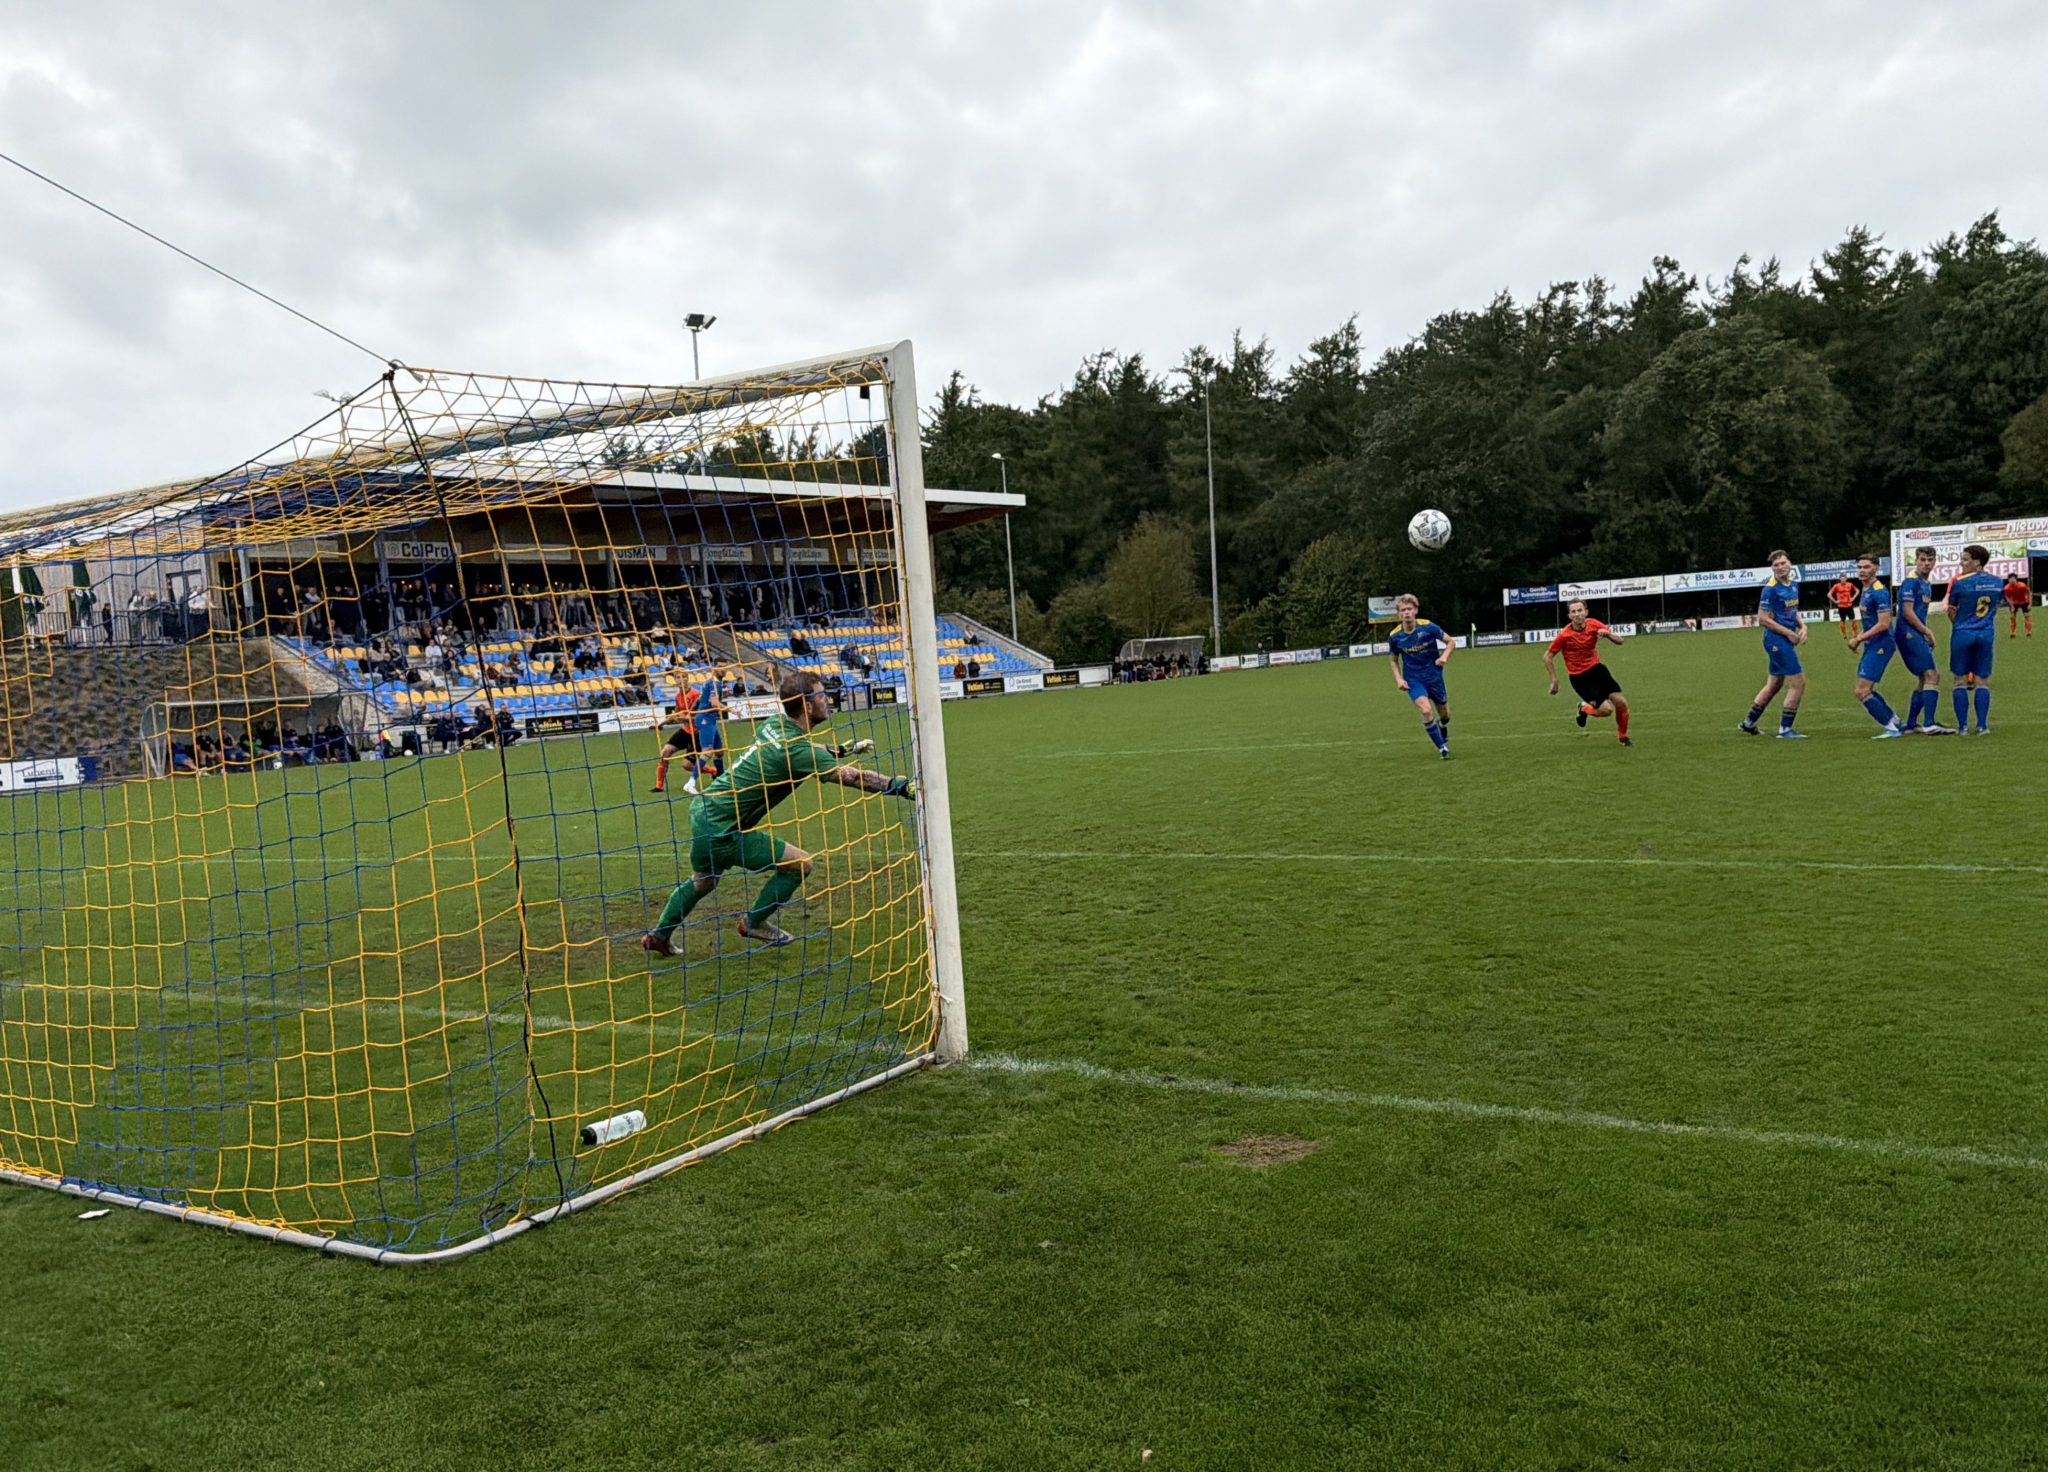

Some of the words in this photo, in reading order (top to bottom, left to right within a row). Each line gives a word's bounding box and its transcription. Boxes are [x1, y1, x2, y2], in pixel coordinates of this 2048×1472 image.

[401, 542, 449, 558] ColPro
[1561, 587, 1609, 598] Oosterhave
[1976, 595, 1992, 618] 6
